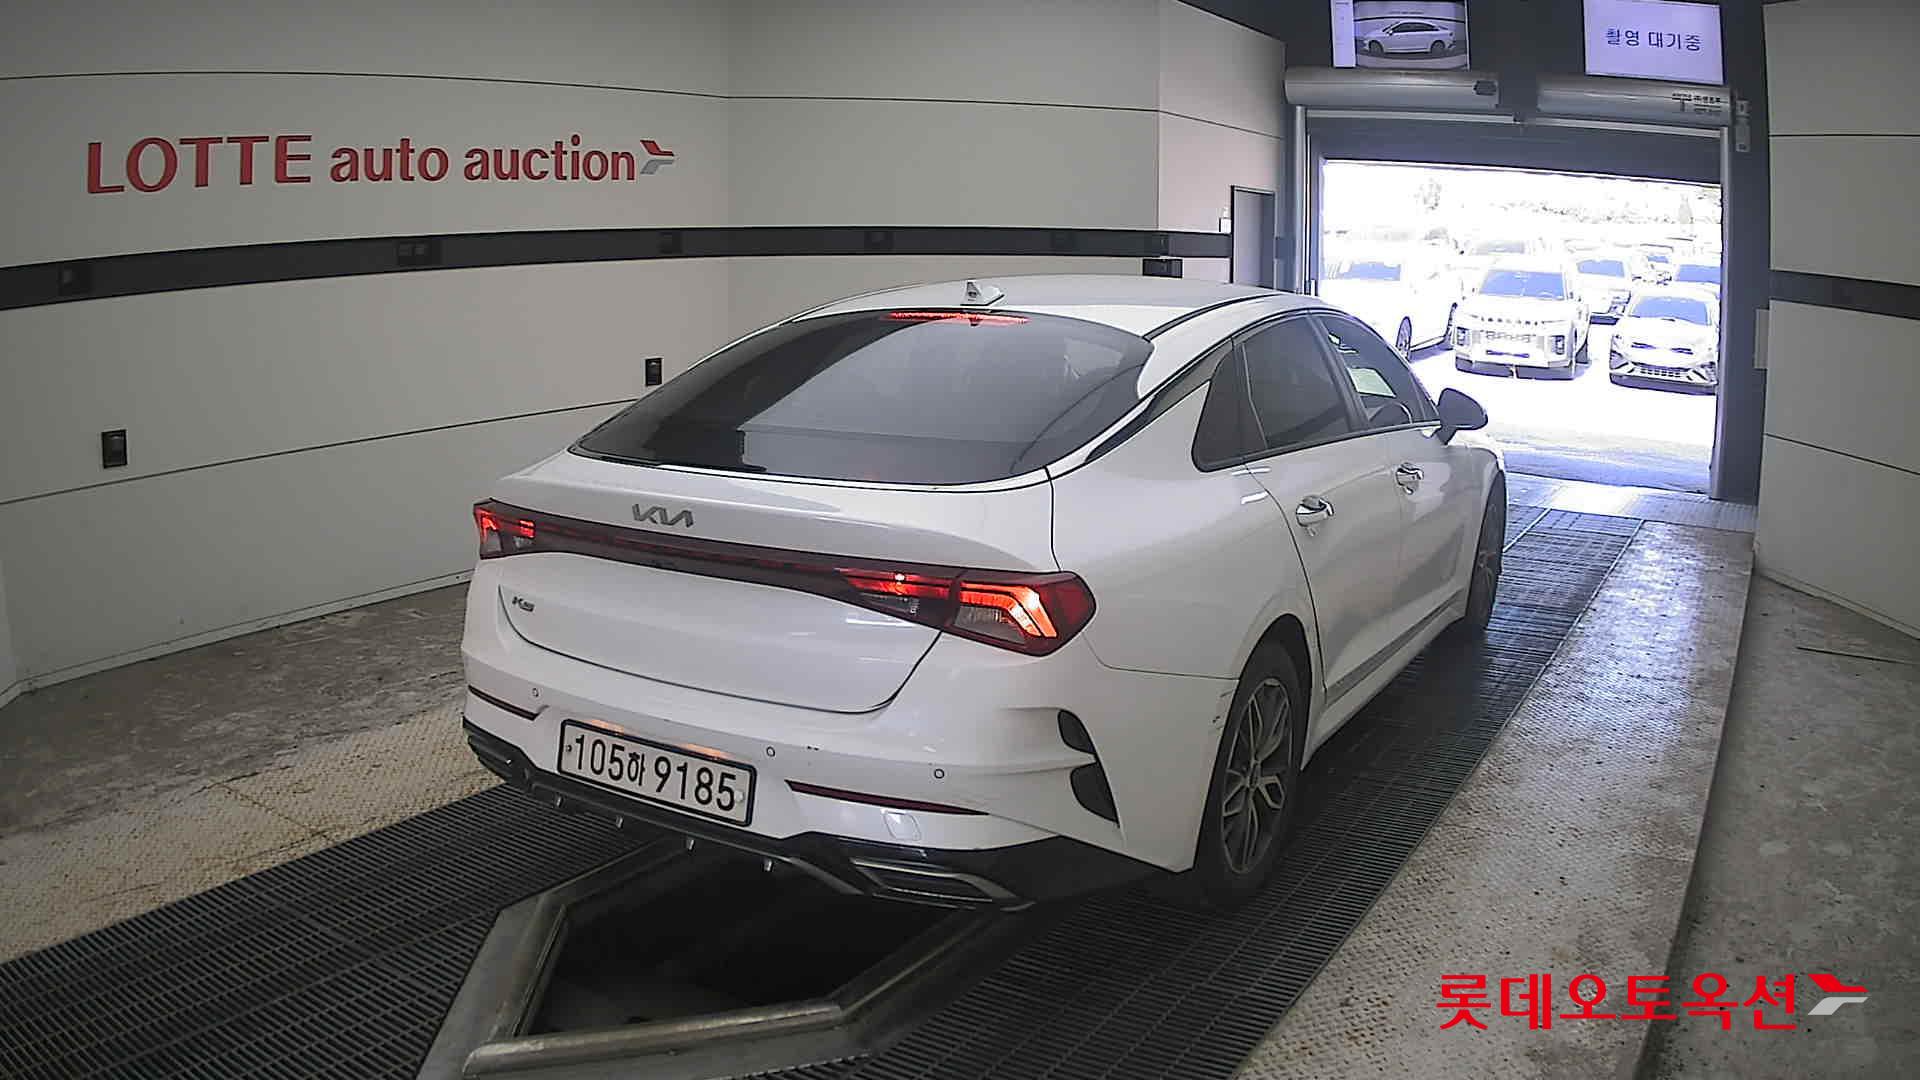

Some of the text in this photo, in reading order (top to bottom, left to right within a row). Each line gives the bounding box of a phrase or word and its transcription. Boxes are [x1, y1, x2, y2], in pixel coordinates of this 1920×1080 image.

[1648, 31, 1702, 52] 대기중
[87, 134, 635, 193] LOTTE auto auction
[632, 503, 694, 528] KIA
[511, 596, 535, 612] K5
[575, 734, 736, 811] 105하 9185
